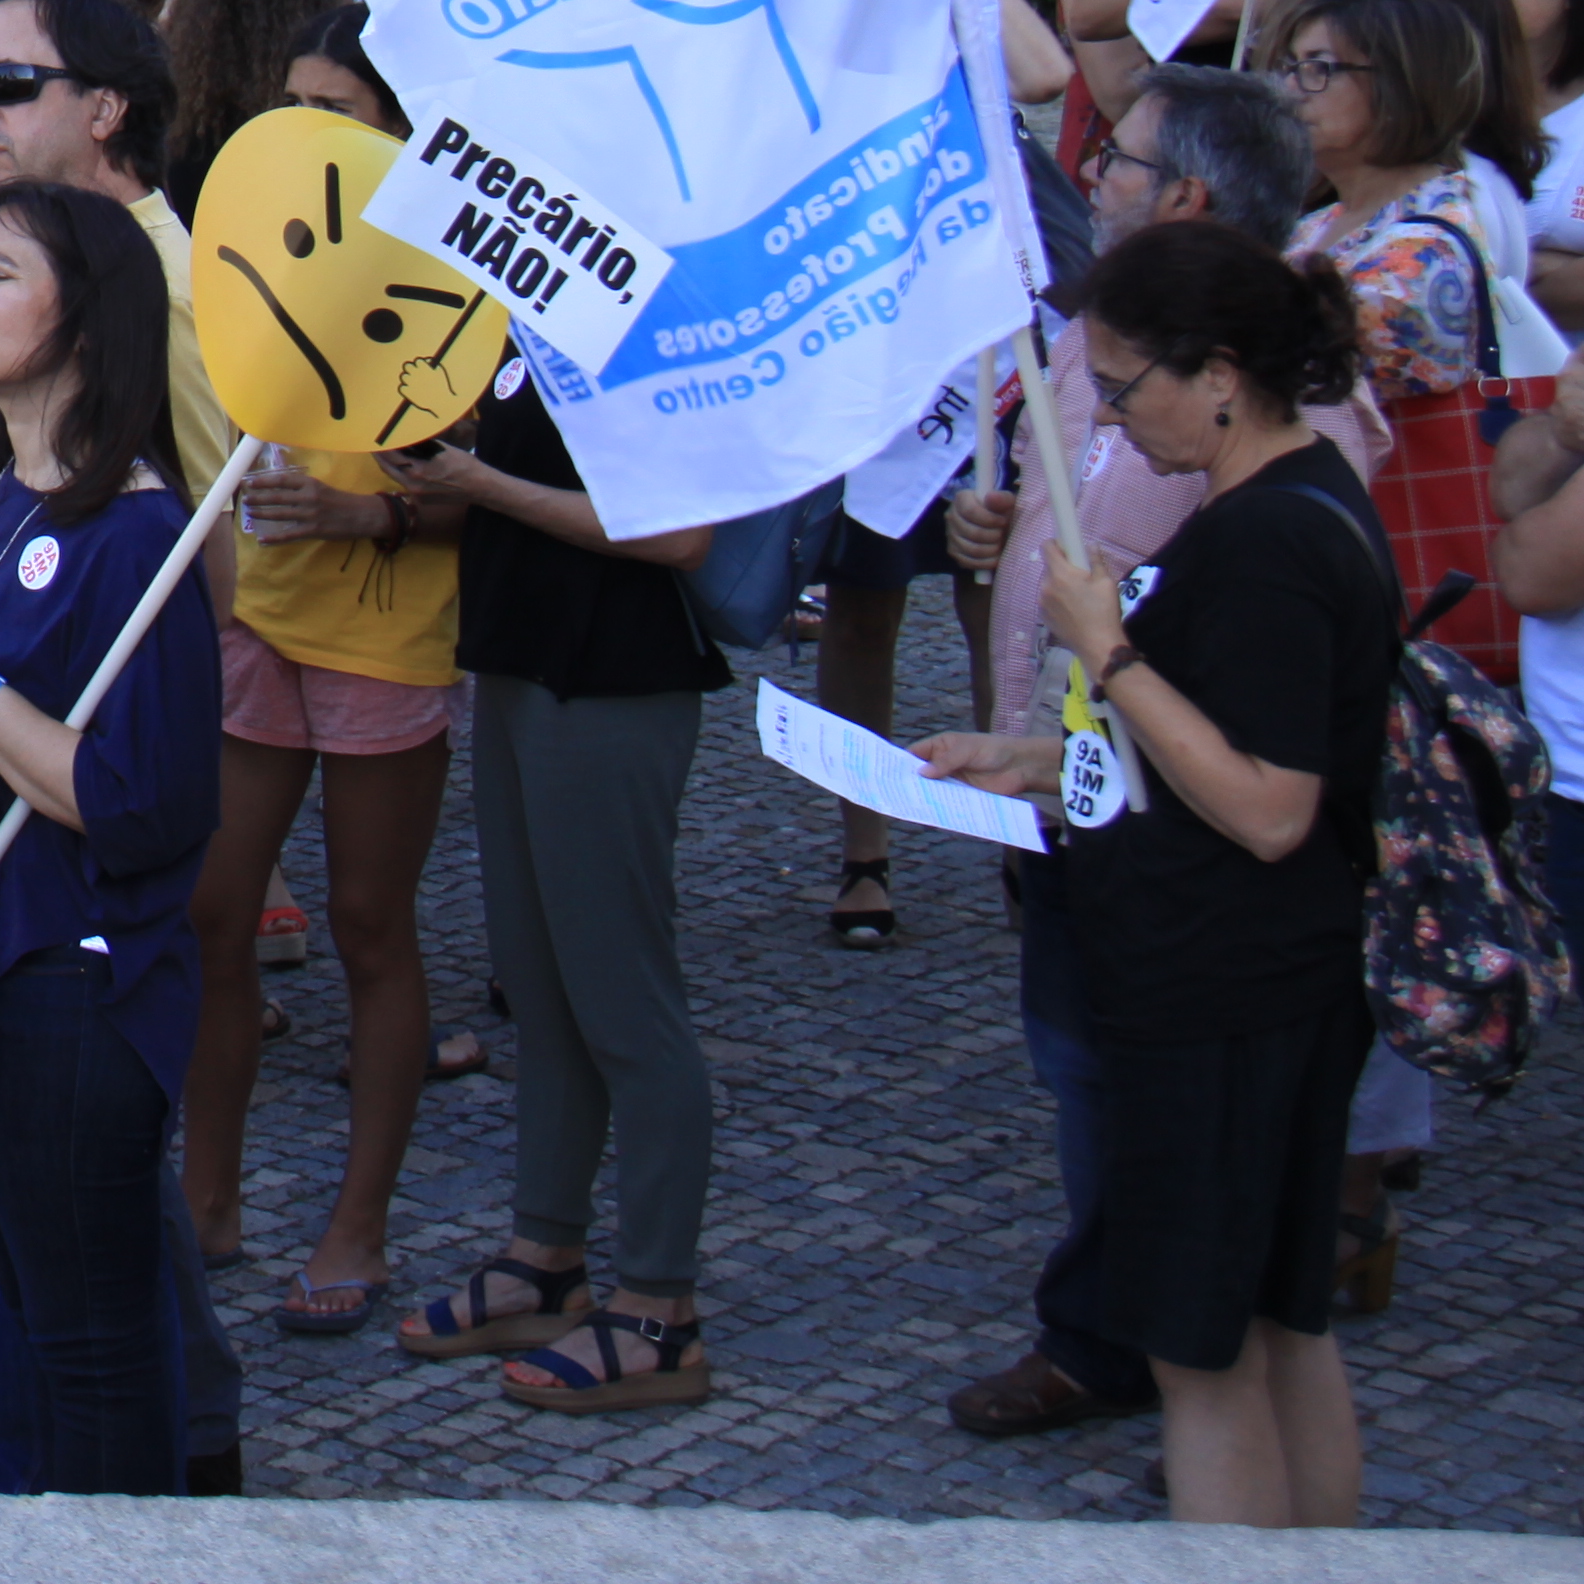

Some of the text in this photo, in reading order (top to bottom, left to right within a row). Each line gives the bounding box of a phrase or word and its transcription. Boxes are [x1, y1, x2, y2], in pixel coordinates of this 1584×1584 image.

[419, 117, 637, 304] Precário,
[441, 202, 569, 315] NÃO!
[33, 552, 48, 577] 4M
[44, 542, 57, 566] 9A
[21, 560, 36, 583] 2D
[1075, 739, 1103, 770] 9A
[1065, 789, 1094, 818] 2D
